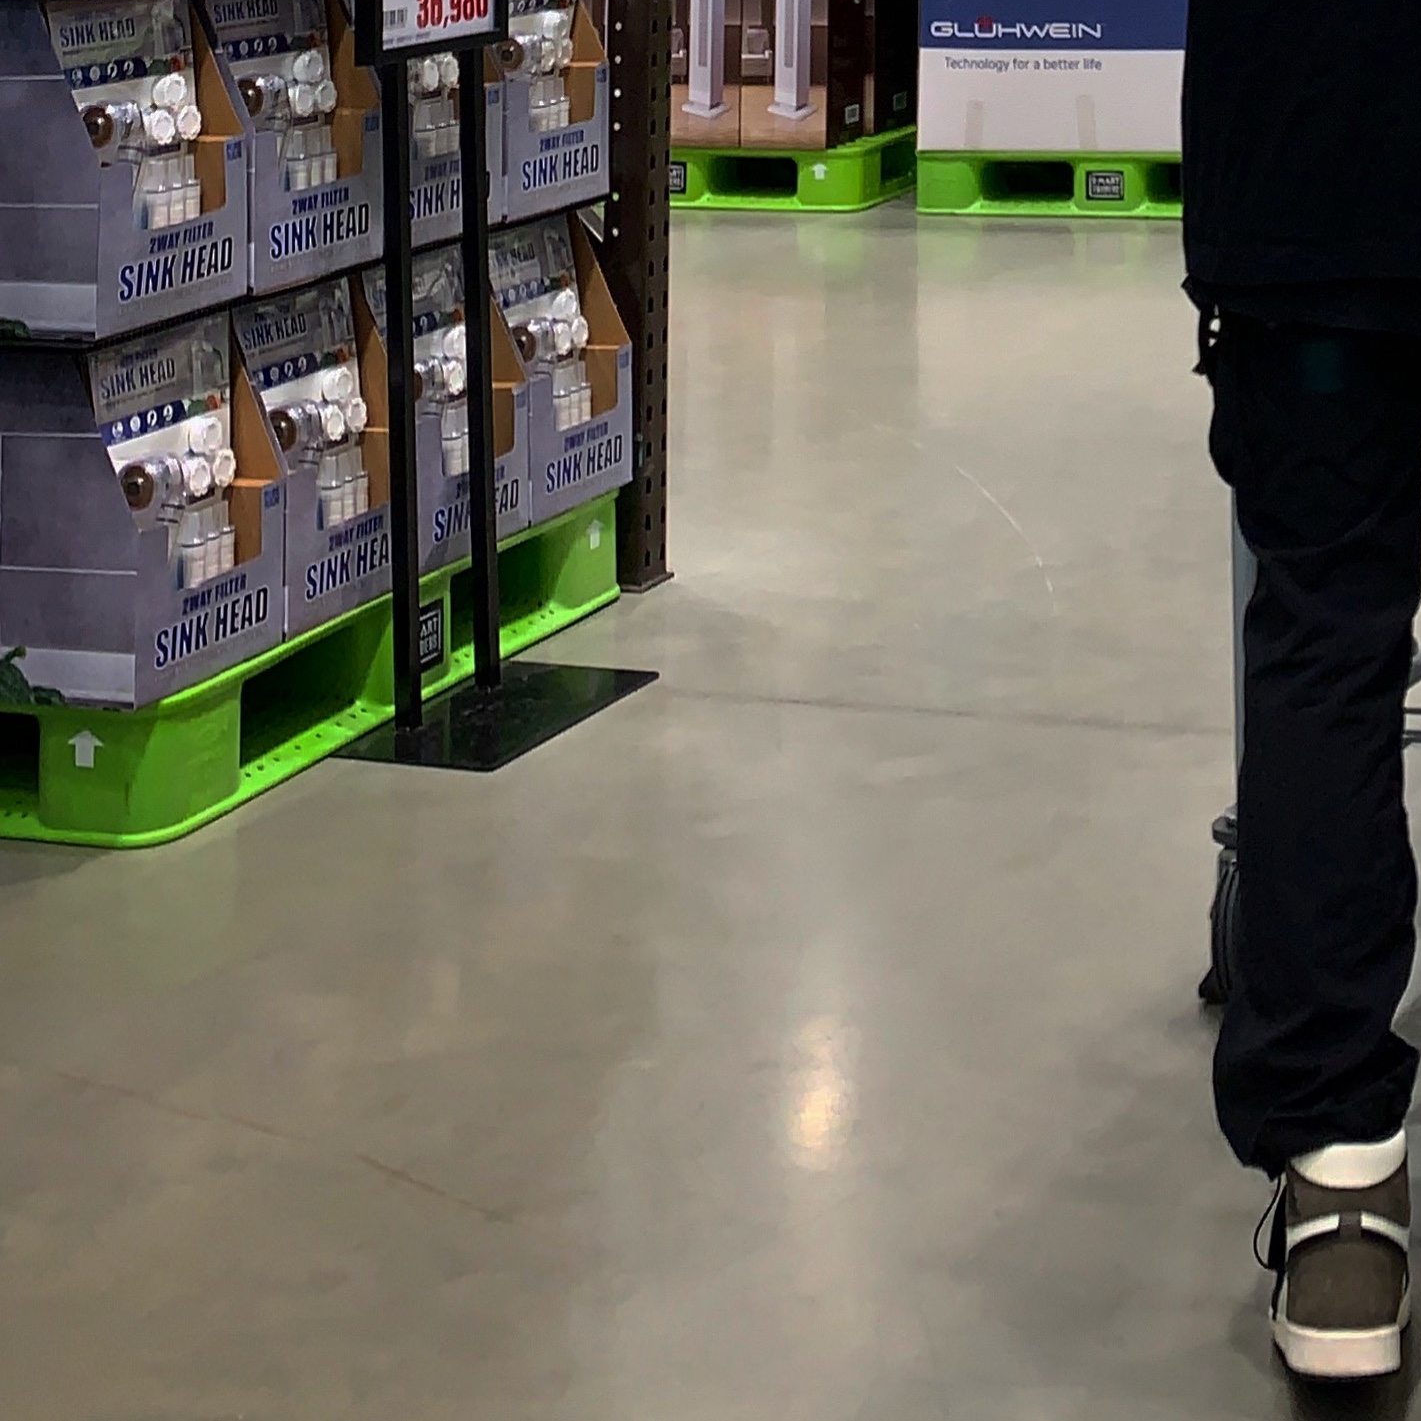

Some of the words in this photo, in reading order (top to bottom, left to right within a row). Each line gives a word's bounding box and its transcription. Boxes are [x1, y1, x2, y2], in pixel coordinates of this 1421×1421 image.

[60, 24, 95, 48] SINK
[98, 17, 136, 42] HEAD
[213, 1, 245, 25] SINK
[945, 56, 1010, 73] Technology
[1012, 56, 1029, 71] for
[1033, 59, 1041, 70] a
[1043, 57, 1079, 71] better
[1082, 57, 1102, 71] life
[522, 154, 559, 192] SINK
[562, 143, 600, 180] HEAD
[291, 196, 318, 217] 2WAY
[320, 187, 350, 210] FILTER
[149, 229, 181, 255] 2WAY
[182, 220, 214, 244] FILTER
[270, 214, 318, 261] SINK
[322, 202, 370, 247] HEAD
[119, 253, 176, 303] SINK
[180, 237, 233, 286] HEAD
[243, 323, 274, 351] SINK
[275, 313, 307, 342] HEAD
[100, 370, 137, 400] SINK
[138, 357, 176, 387] HEAD
[545, 456, 583, 495] SINK
[586, 434, 623, 474] HEAD
[434, 503, 471, 544] SIN
[305, 549, 352, 600] SINK
[355, 533, 390, 578] HEA
[181, 588, 213, 616] 2WAY
[214, 573, 248, 602] FILTER
[155, 613, 210, 668] SINK
[214, 585, 269, 643] HEAD
